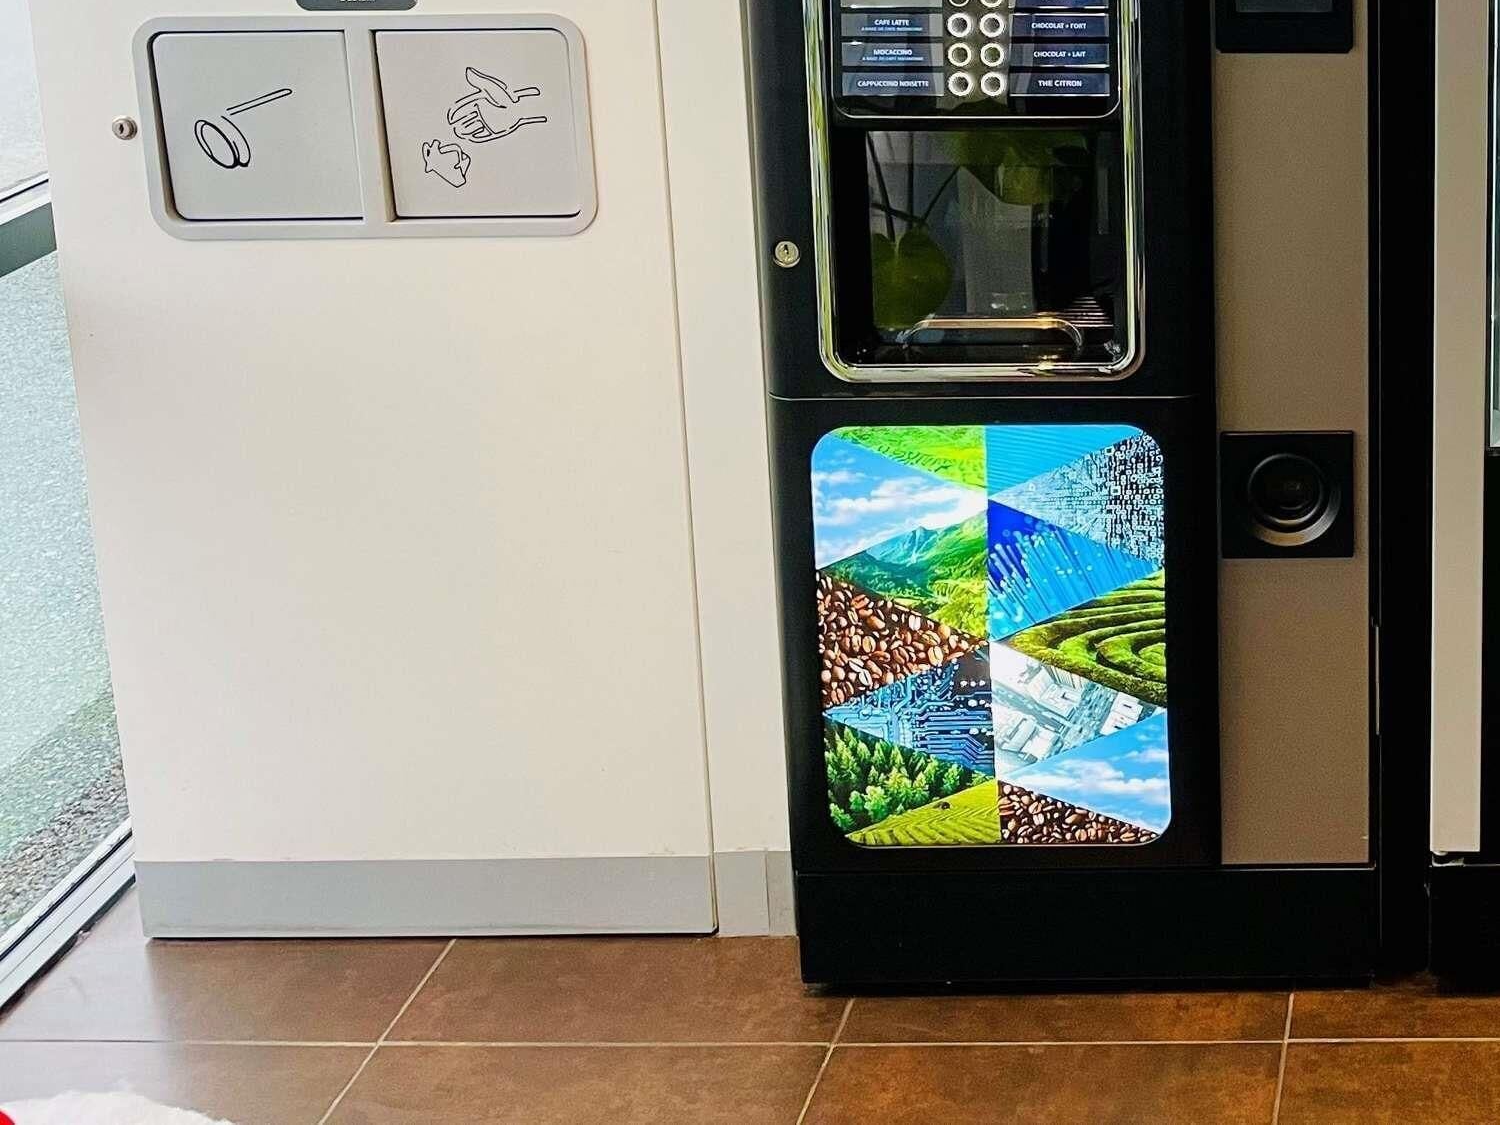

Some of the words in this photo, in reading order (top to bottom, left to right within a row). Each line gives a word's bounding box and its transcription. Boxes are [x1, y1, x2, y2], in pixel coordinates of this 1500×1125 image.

[1032, 22, 1064, 30] CHOCOLAT
[1070, 22, 1087, 30] FORT
[1033, 50, 1066, 58] CHOCOLAT
[1072, 50, 1086, 58] LAIT
[857, 80, 899, 88] CAPPUCCINO
[900, 80, 930, 88] NOISETTE
